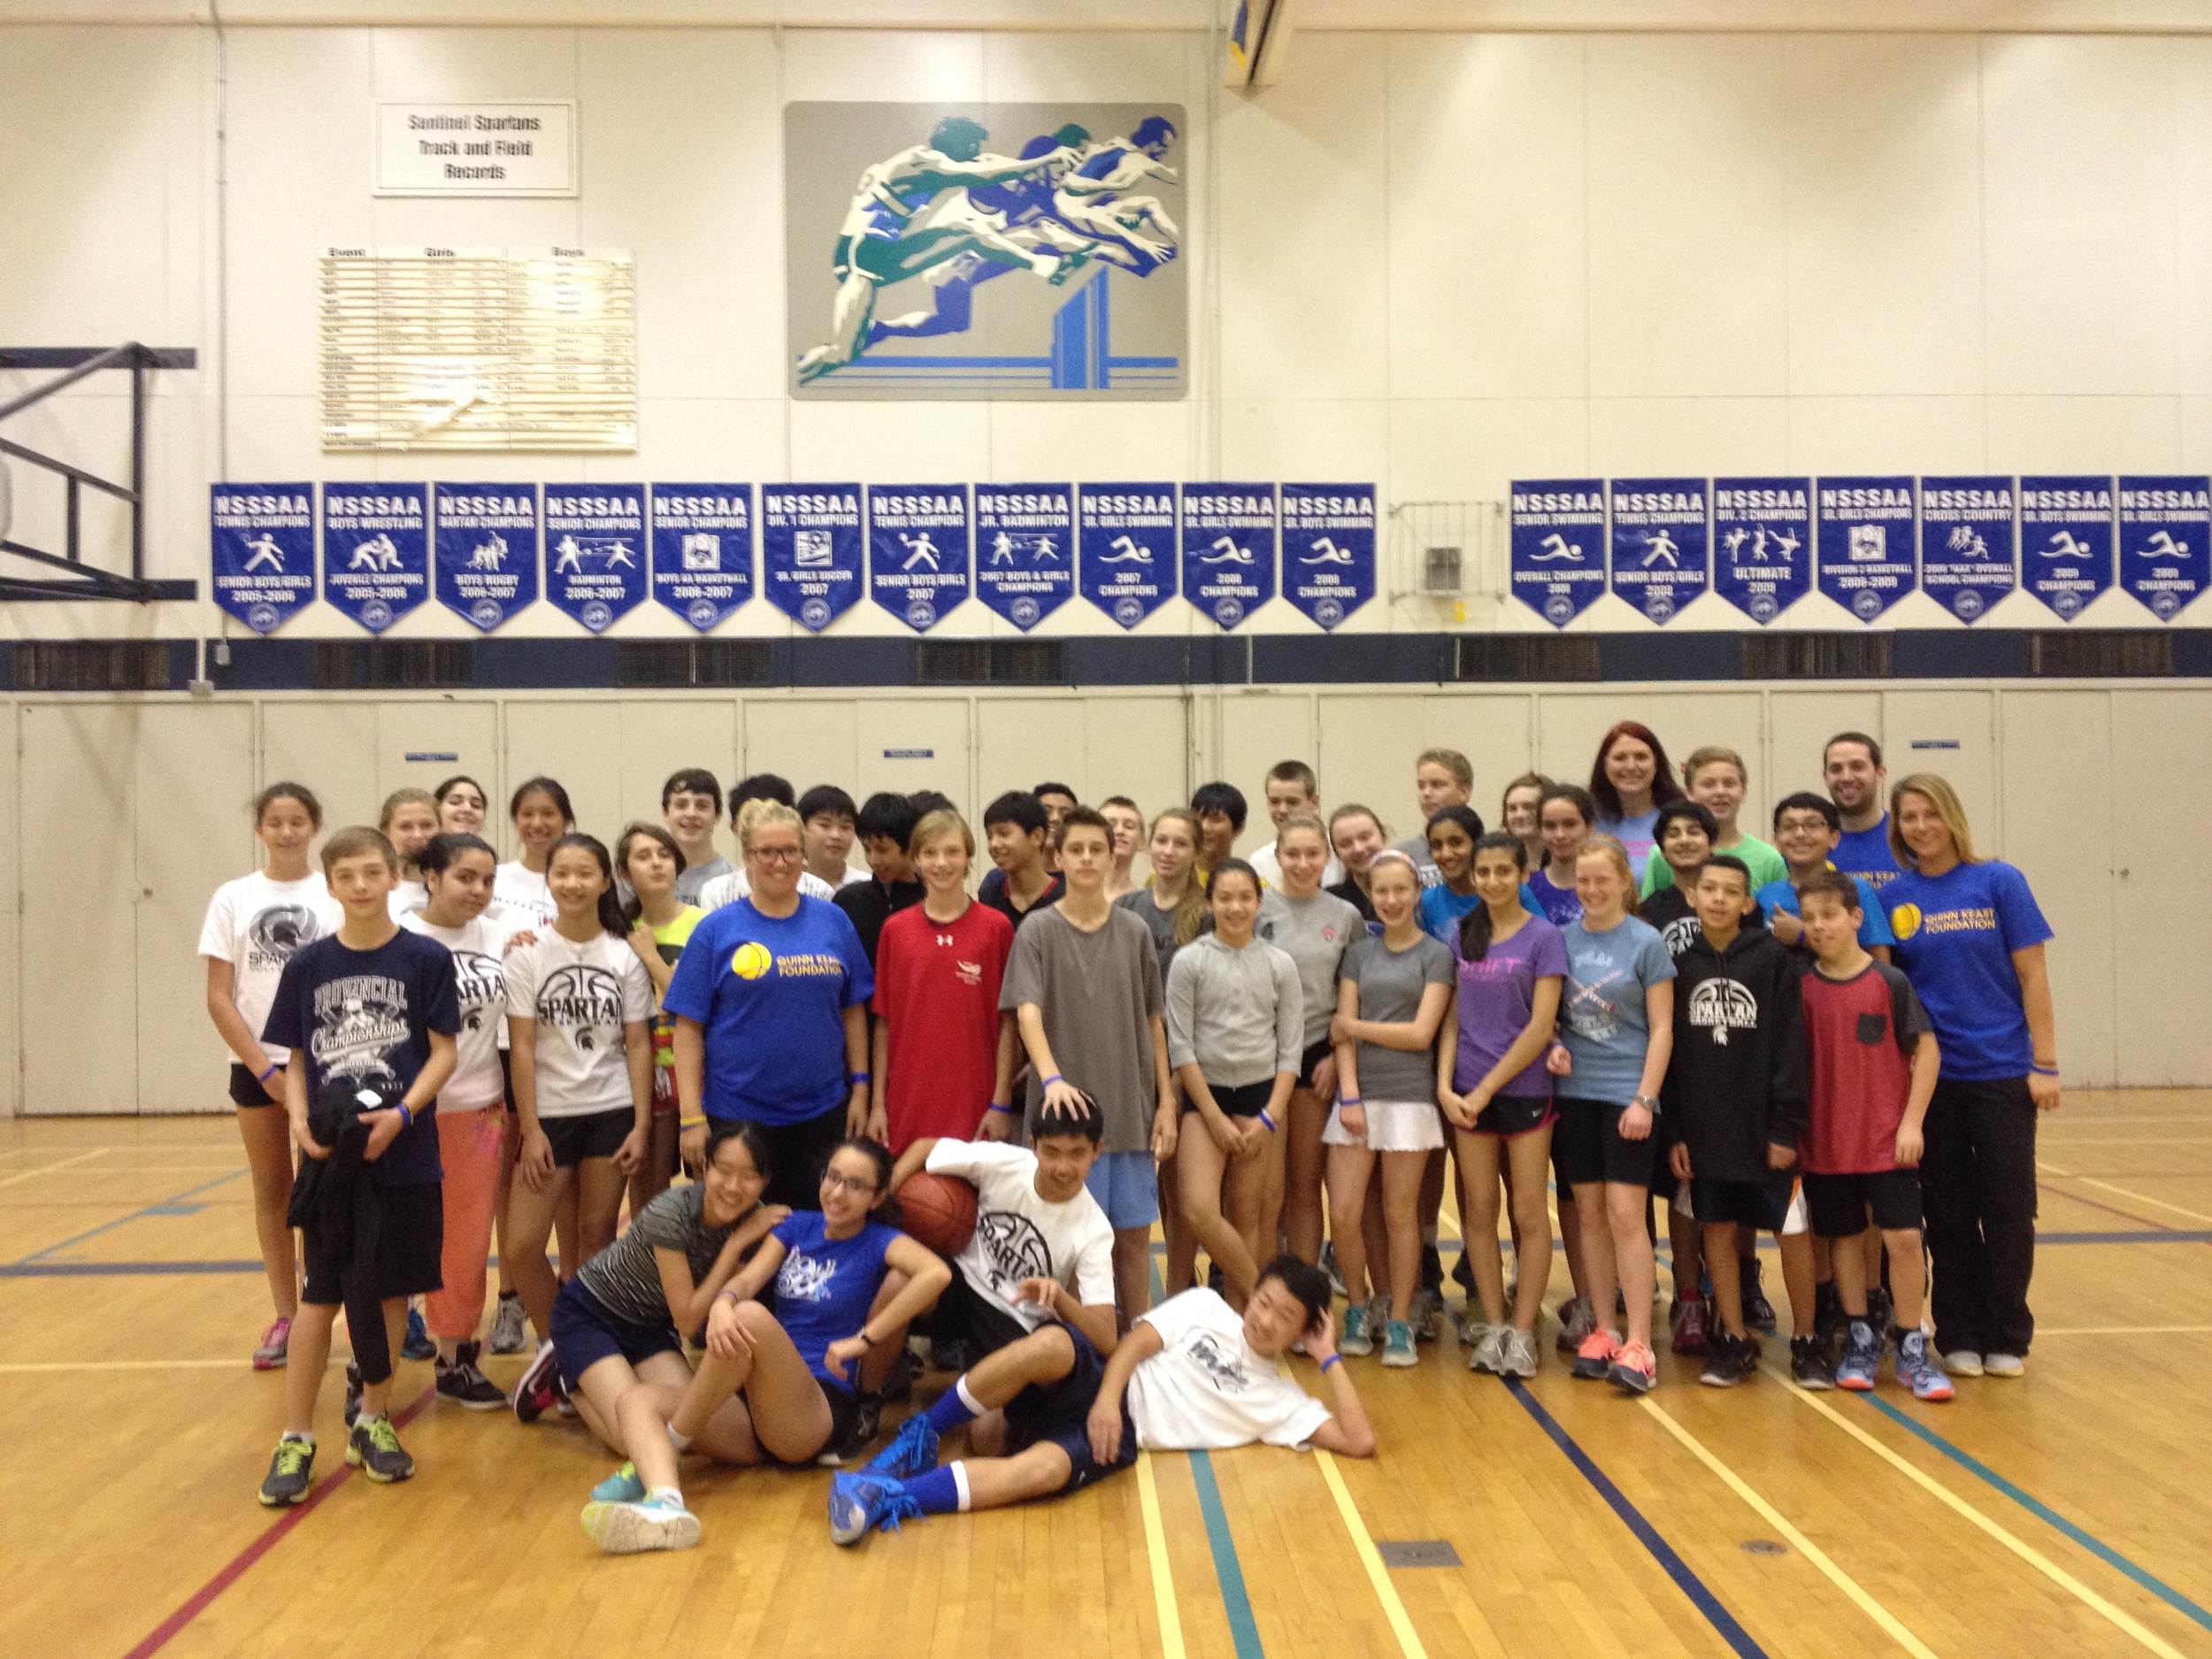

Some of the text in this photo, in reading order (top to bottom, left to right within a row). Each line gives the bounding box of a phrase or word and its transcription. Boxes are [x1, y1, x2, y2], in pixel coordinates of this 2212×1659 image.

[408, 115, 541, 132] Sentinel Spartans
[419, 140, 533, 156] Track and Field
[444, 164, 506, 179] Records
[1513, 493, 1604, 512] NSSSAA
[1613, 493, 1704, 512] NSSSAA
[1716, 490, 1807, 509] NSSSAA
[1820, 488, 1912, 508] NSSSAA
[1924, 490, 2012, 509] NSSSAA
[2022, 491, 2111, 509] NSSSAA
[2120, 490, 2209, 509] NSSSAA
[215, 495, 310, 515] NSSSAA
[327, 496, 421, 515] NSSSAA
[439, 496, 534, 515] NSSSAA
[547, 497, 640, 516] NSSSAA
[654, 497, 747, 517] NSSSAA
[765, 495, 857, 514] NSSSAA
[872, 495, 964, 515] NSSSAA
[979, 495, 1068, 514] NSSSAA
[1081, 495, 1172, 514] NSSSAA
[1184, 496, 1274, 516] NSSSAA
[1283, 496, 1374, 516] NSSSAA
[768, 514, 858, 526] DIV. 1 CHAMPIONS
[1514, 513, 1603, 526] SENIOR SWIMMING
[1615, 512, 1705, 525] TENNIS CHAMPIONS
[1718, 509, 1808, 521] DIV. 2 CHAMPIONS
[1822, 508, 1912, 520] SR. GIRLS CHAMPIONS
[1924, 510, 2012, 522] CROSS COUNTRY
[2024, 511, 2111, 523] SR. BOYS SWIMMING
[2122, 511, 2209, 523] SR. GIRLS SWIMMING
[217, 516, 310, 528] TENNIS CHAMPIONS
[329, 517, 423, 529] BOYS WRESTLING
[438, 517, 534, 528] BANTAM CHAMPIONS
[548, 518, 641, 530] SENIOR CHAMPIONS
[655, 518, 747, 529] SENIOR CHAMPIONS
[874, 516, 964, 527] TENNIS CHAMPIONS
[980, 515, 1069, 527] JR. BADMINTON
[1083, 516, 1173, 528] SR. GIRLS SWIMMING
[1185, 517, 1273, 529] SR. GIRLS SWIMMING
[1284, 517, 1373, 529] SR. BOYS SWIMMING
[1732, 567, 1792, 580] ULTIMATE
[1822, 565, 1858, 574] DIVISION
[1867, 564, 1913, 574] BASKETBALL
[1977, 564, 2012, 573] OVERALL
[218, 575, 311, 588] SENIOR BOYS/GIRLS
[330, 573, 424, 586] JUVENILE CHAMPIONS
[454, 574, 519, 586] BOYS RUGBY
[568, 575, 622, 586] BADMINTON
[656, 573, 680, 584] BOYS
[696, 573, 747, 584] BASKETBALL
[794, 571, 818, 581] GIRLS
[819, 571, 852, 581] SOCCER
[876, 574, 965, 586] SENIOR BOYS/GIRLS
[979, 571, 1070, 581] 2007 BOYS & GIRLS
[1115, 572, 1141, 584] 2007
[1515, 570, 1604, 582] OVERALL CHAMPIONS
[1616, 571, 1704, 583] SENIOR BOYS/GIRLS
[1924, 574, 2013, 585] SCHOOL CHAMPIONS
[800, 583, 828, 595] 2007
[996, 582, 1053, 593] CHAMPIONS
[1099, 585, 1157, 596] CHAMPIONS
[2037, 580, 2095, 592] CHAMPIONS
[2136, 580, 2195, 591] CHAMPIONS
[907, 588, 934, 600] 2007
[1201, 586, 1258, 598] CHAMPIONS
[1298, 587, 1356, 598] CHAMPIONS
[1924, 908, 1994, 924] QUINN KEAST
[1925, 919, 1995, 934] FOUNDATION
[777, 954, 813, 964] QUINN
[313, 975, 408, 1017] PROVINCIAL
[311, 1016, 411, 1059] Championships
